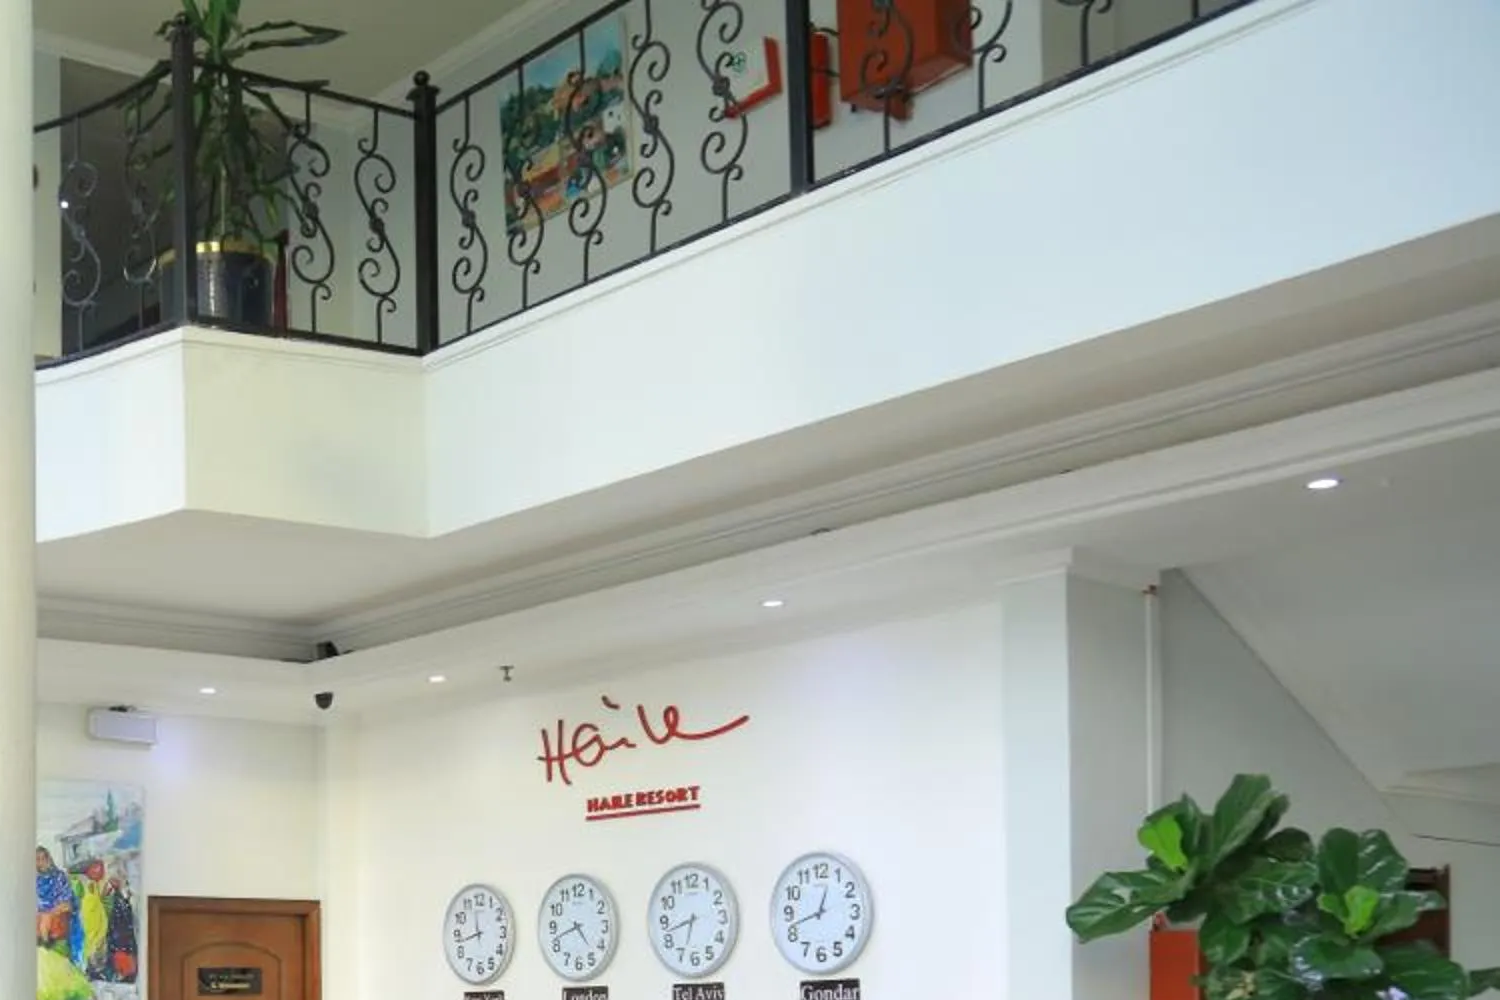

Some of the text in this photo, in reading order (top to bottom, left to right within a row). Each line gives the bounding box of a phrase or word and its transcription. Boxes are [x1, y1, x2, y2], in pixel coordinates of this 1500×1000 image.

[635, 785, 700, 807] RESORT
[797, 868, 810, 884] 11
[813, 863, 828, 879] 12
[834, 868, 840, 883] 1
[671, 880, 682, 894] 11
[685, 874, 698, 888] 12
[703, 878, 709, 891] 1
[560, 888, 569, 901] 11
[572, 884, 584, 897] 12
[589, 888, 594, 900] 1
[786, 886, 800, 901] 10
[845, 881, 855, 898] 2
[662, 896, 674, 910] 10
[714, 890, 722, 905] 2
[550, 903, 562, 916] 10
[597, 901, 605, 914] 2
[784, 905, 794, 922] 9
[850, 903, 860, 920] 3
[660, 915, 668, 930] 9
[718, 909, 727, 925] 3
[549, 920, 556, 934] 9
[601, 920, 608, 934] 3
[788, 925, 797, 942] 8
[845, 925, 855, 941] 4
[664, 934, 674, 948] 8
[714, 930, 724, 944] 4
[553, 939, 560, 952] 8
[597, 939, 605, 950] 4
[801, 941, 810, 957] 7
[833, 941, 843, 957] 5
[564, 952, 570, 966] 7
[587, 952, 596, 966] 5
[676, 948, 685, 963] 7
[690, 952, 700, 966] 6
[705, 946, 714, 960] 5
[816, 946, 826, 962] 6
[576, 956, 583, 970] 6
[674, 985, 724, 1000] Tel Aviv
